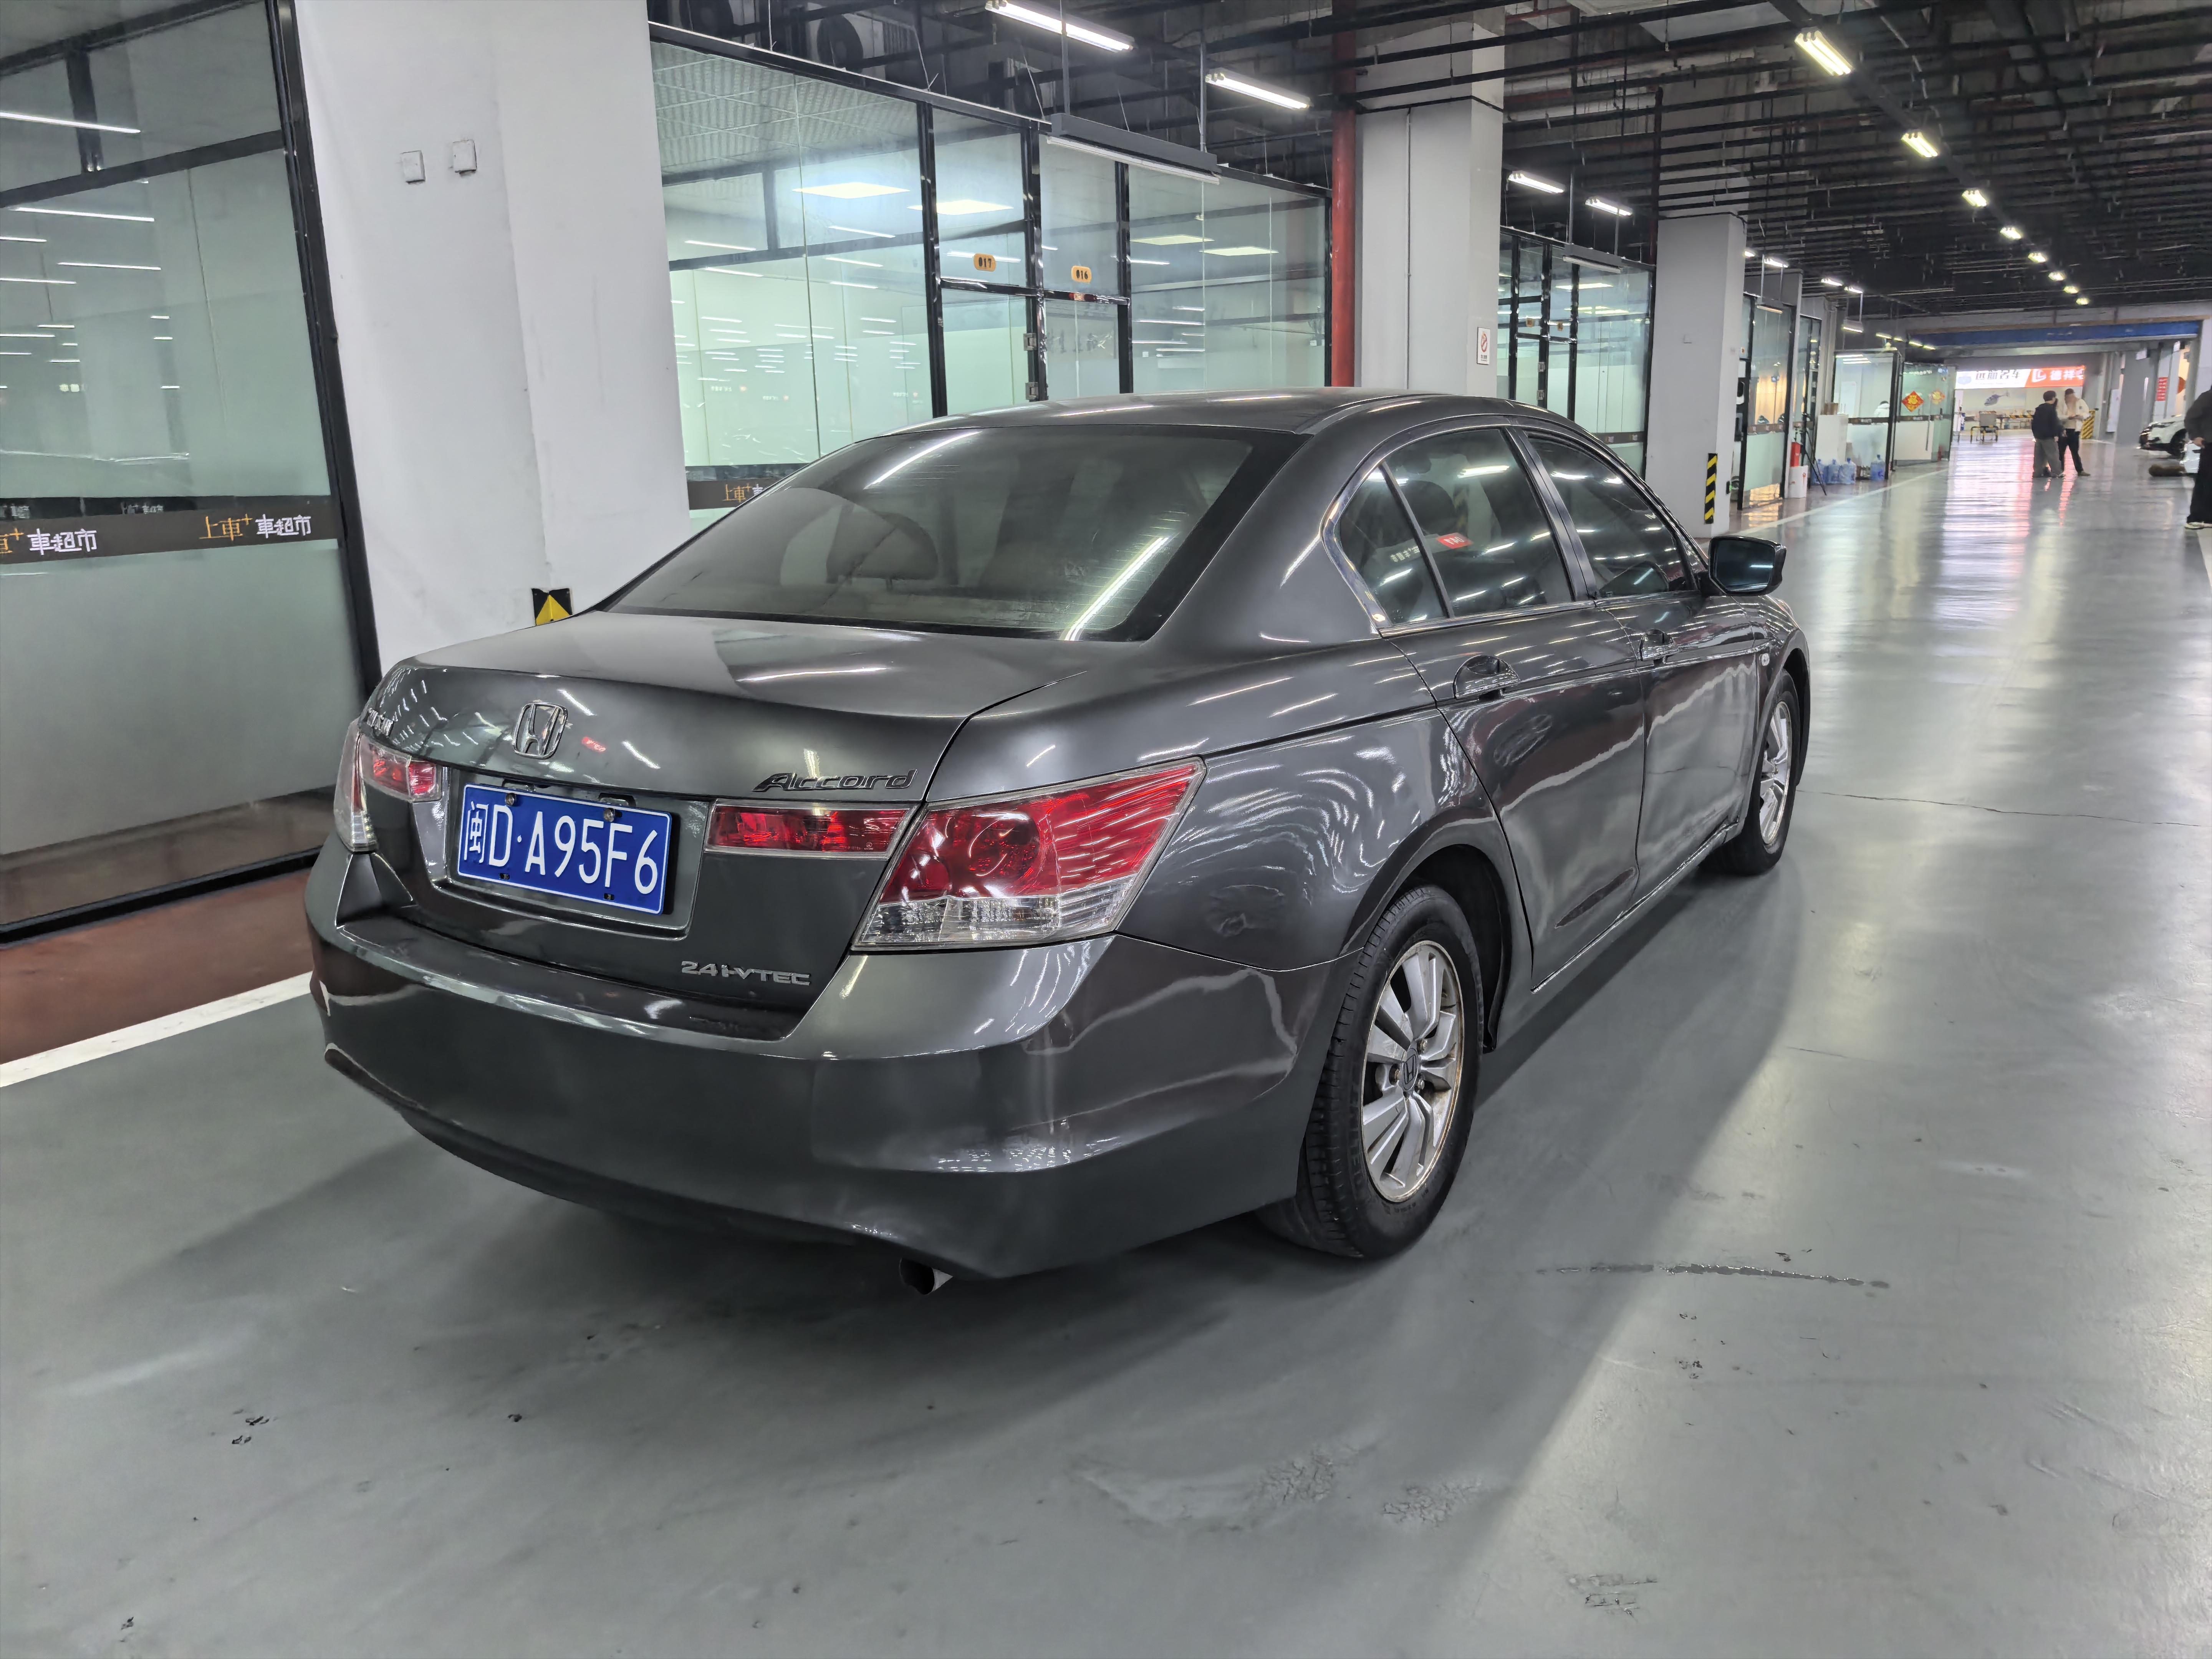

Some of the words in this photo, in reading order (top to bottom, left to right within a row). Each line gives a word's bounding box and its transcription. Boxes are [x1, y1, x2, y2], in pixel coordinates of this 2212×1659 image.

[978, 257, 992, 268] 017
[1076, 269, 1088, 280] 016
[752, 768, 918, 792] Accord
[464, 801, 658, 895] 闽D·A95F6
